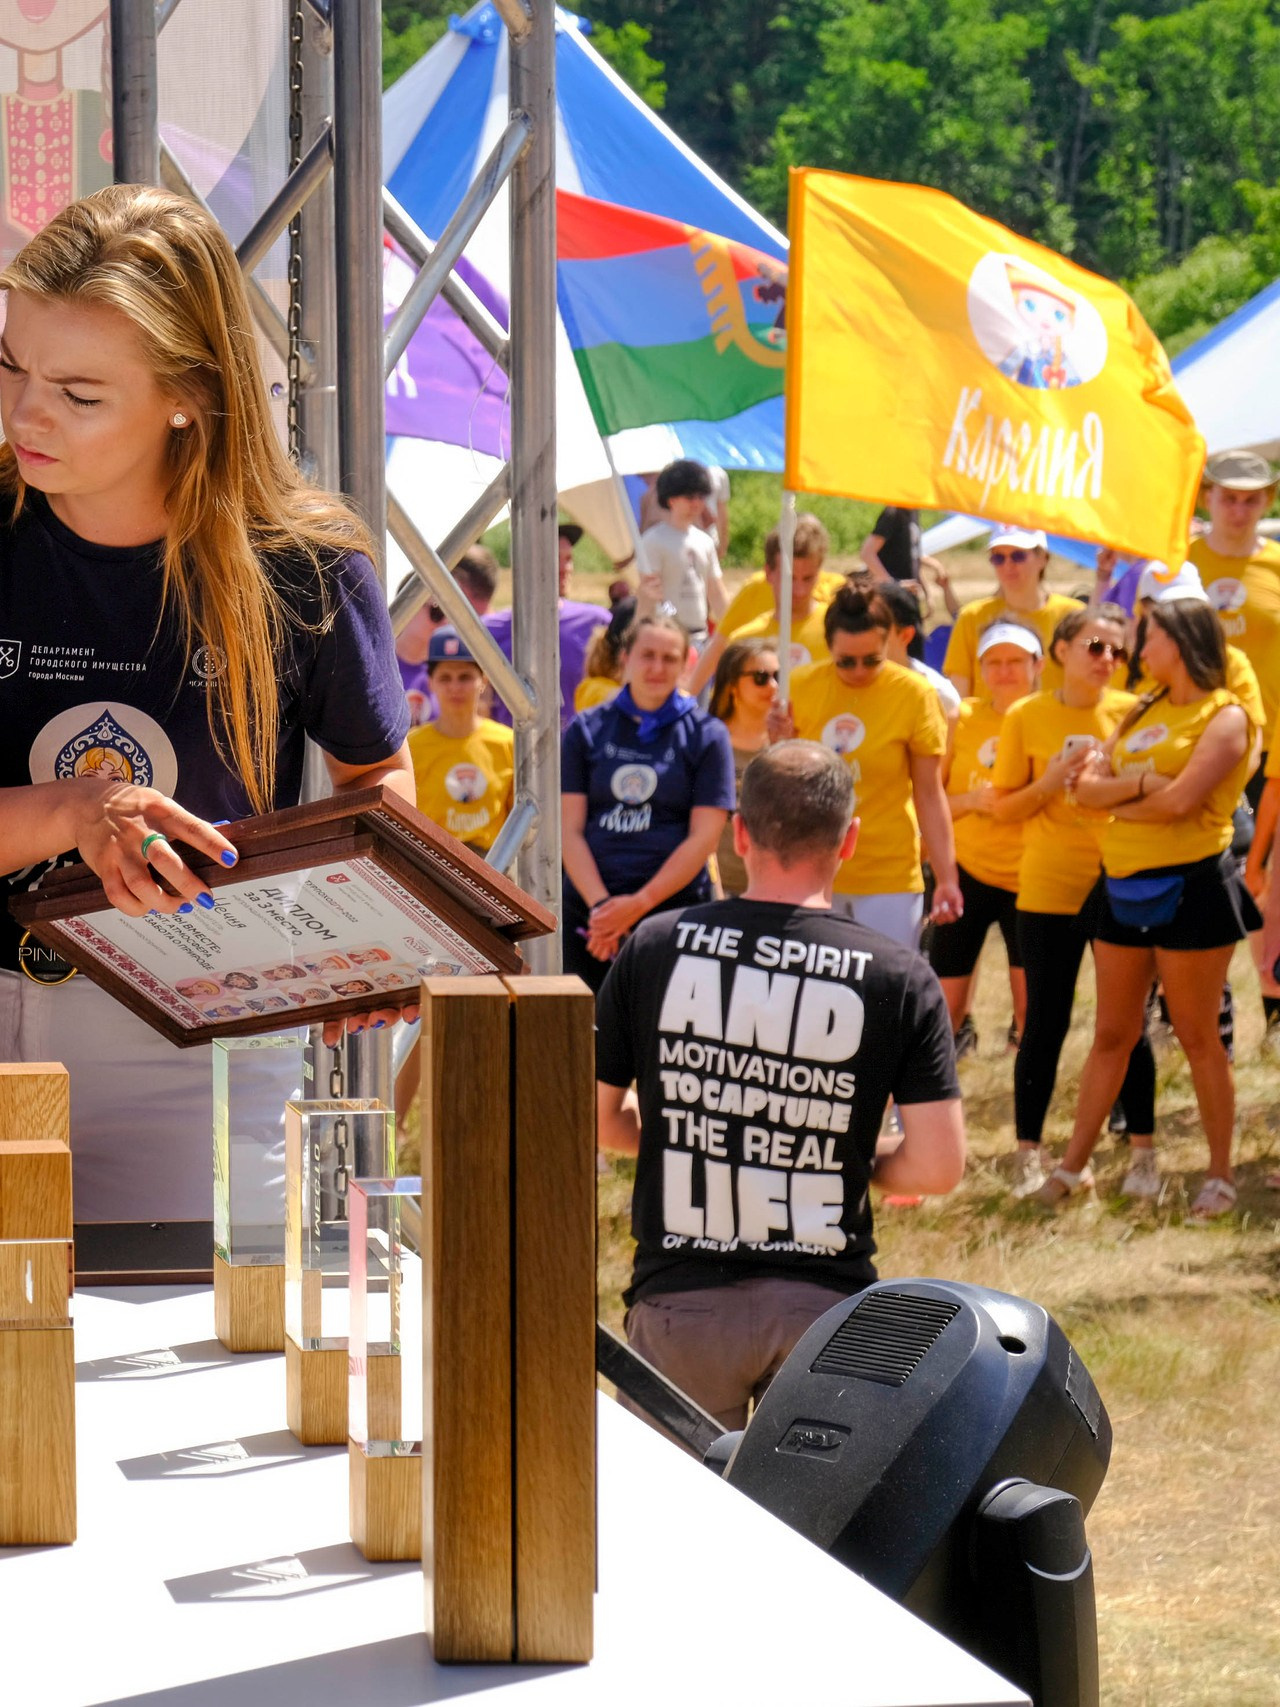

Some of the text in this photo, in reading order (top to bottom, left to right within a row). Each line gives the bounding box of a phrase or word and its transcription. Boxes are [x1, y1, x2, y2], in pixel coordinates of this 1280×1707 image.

[28, 671, 85, 682] города Москвы
[29, 657, 147, 672] ГОРОДСКОГО ИМУЩЕСТВА
[31, 644, 96, 657] ДЕПАРТАМЕНТ
[243, 891, 260, 902] за
[257, 901, 273, 909] 3
[266, 910, 303, 936] место
[259, 887, 338, 940] ДИПЛОМ
[167, 923, 213, 958] АТМОСФЕРА
[676, 921, 873, 981] THE SPIRIT
[658, 954, 865, 1063] AND
[659, 1038, 856, 1099] MOTIVATIONS
[659, 1070, 853, 1134] TO CAPTURE
[661, 1107, 844, 1171] THE REAL
[662, 1148, 847, 1251] LIFE
[662, 1234, 688, 1250] OF
